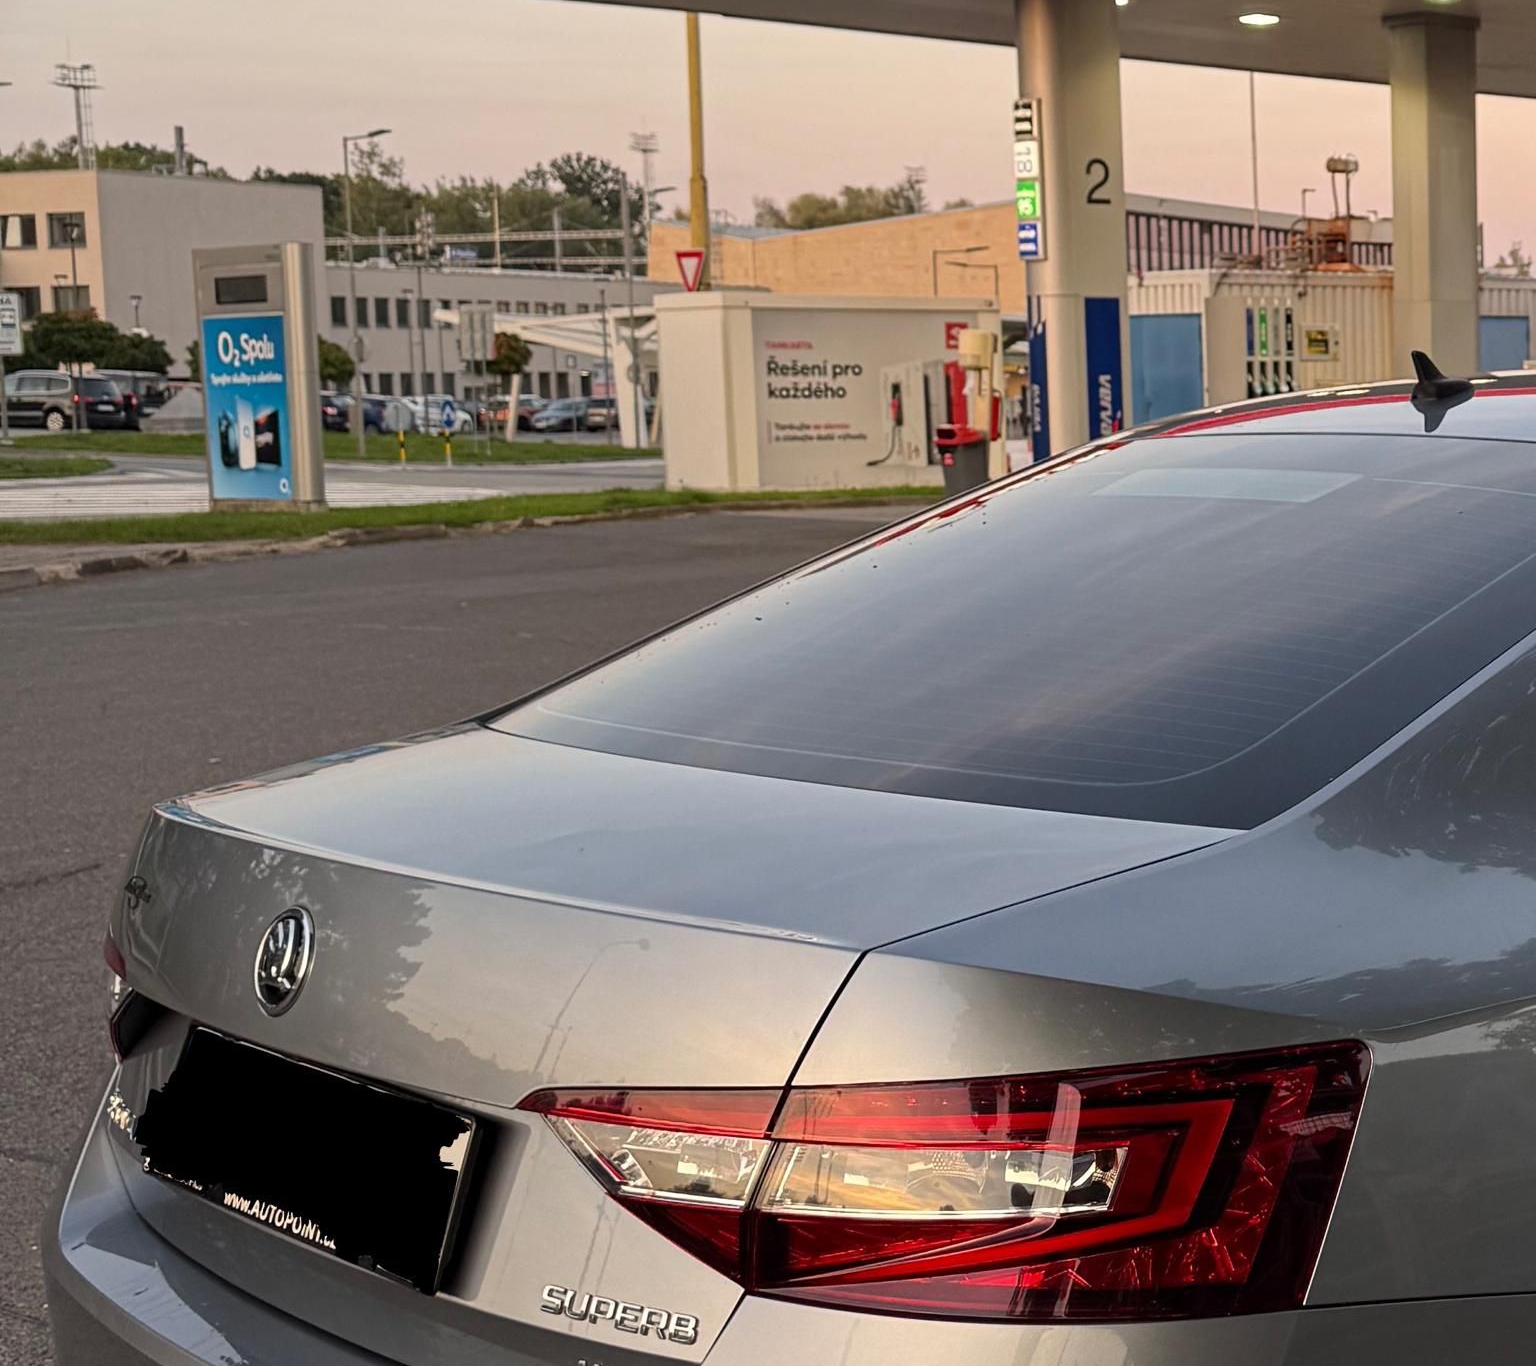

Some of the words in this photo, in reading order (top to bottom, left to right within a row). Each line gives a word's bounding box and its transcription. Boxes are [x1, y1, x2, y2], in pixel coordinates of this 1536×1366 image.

[1085, 157, 1112, 205] 2
[240, 332, 275, 367] Spolu
[766, 355, 828, 376] Řešení
[831, 363, 863, 380] pro
[767, 381, 848, 399] každého
[540, 1284, 700, 1346] SUPERB
